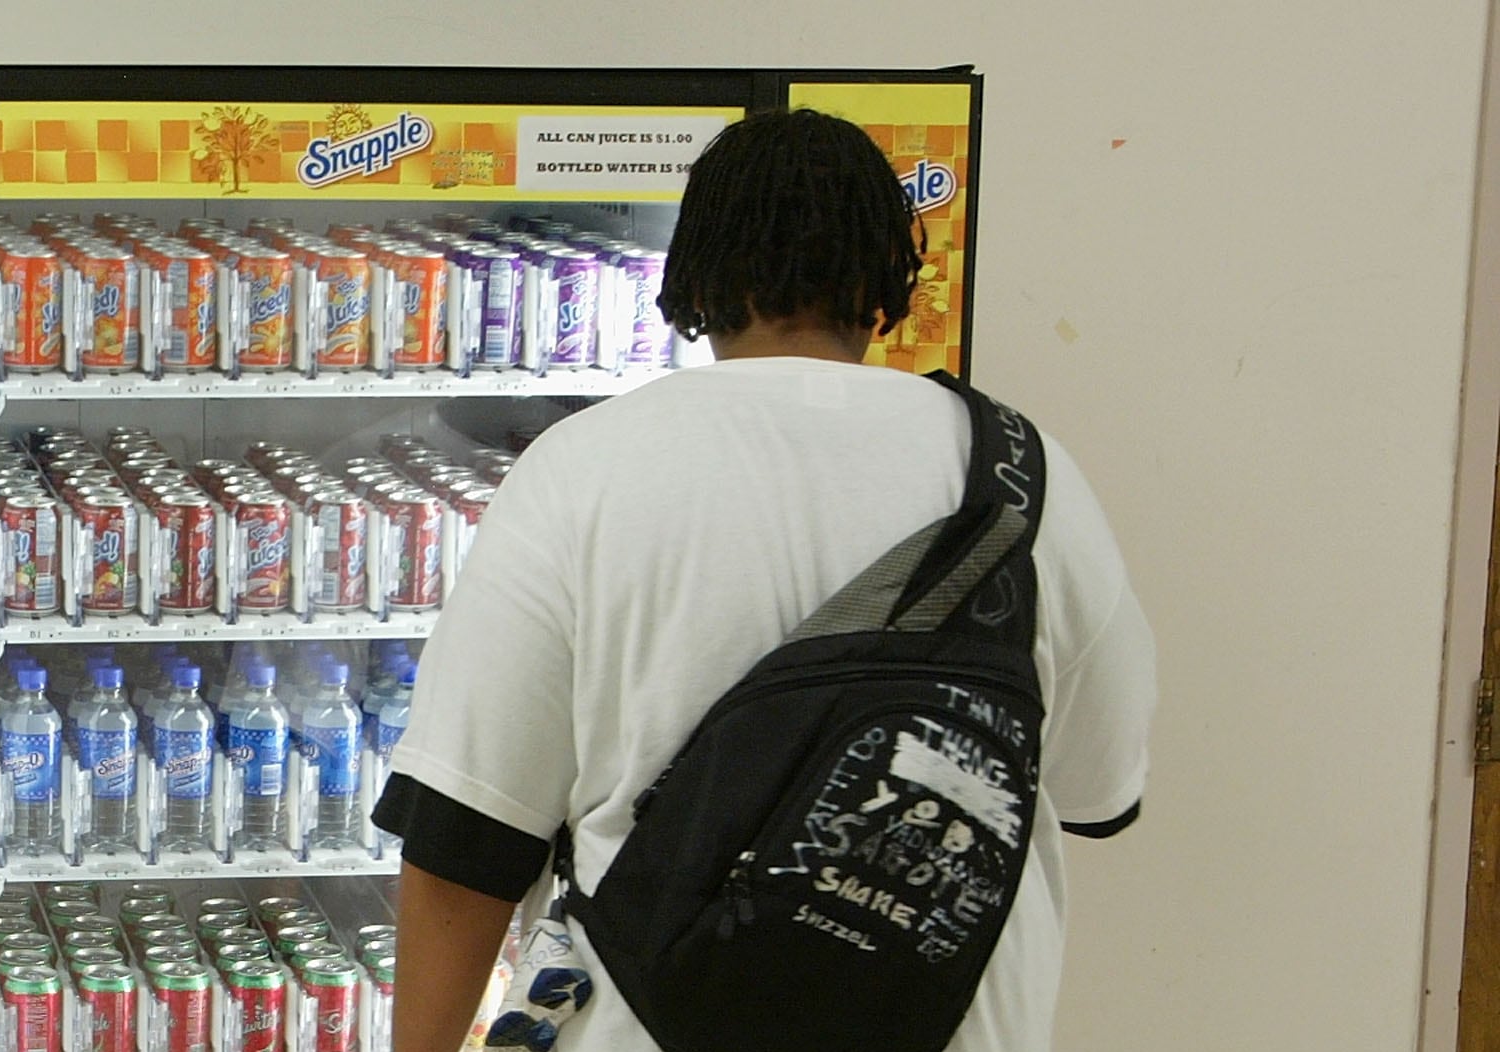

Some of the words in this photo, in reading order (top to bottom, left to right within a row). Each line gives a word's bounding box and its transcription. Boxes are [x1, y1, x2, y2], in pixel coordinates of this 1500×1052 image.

[305, 112, 424, 180] Snapple
[537, 133, 563, 143] ALL
[566, 133, 595, 143] CAN
[599, 133, 637, 145] JUICE
[640, 133, 653, 144] IS
[656, 134, 693, 144] $1.00
[537, 162, 604, 173] BOTTLED
[607, 163, 657, 173] WATER
[660, 163, 673, 173] IS
[813, 865, 917, 931] SHAKE
